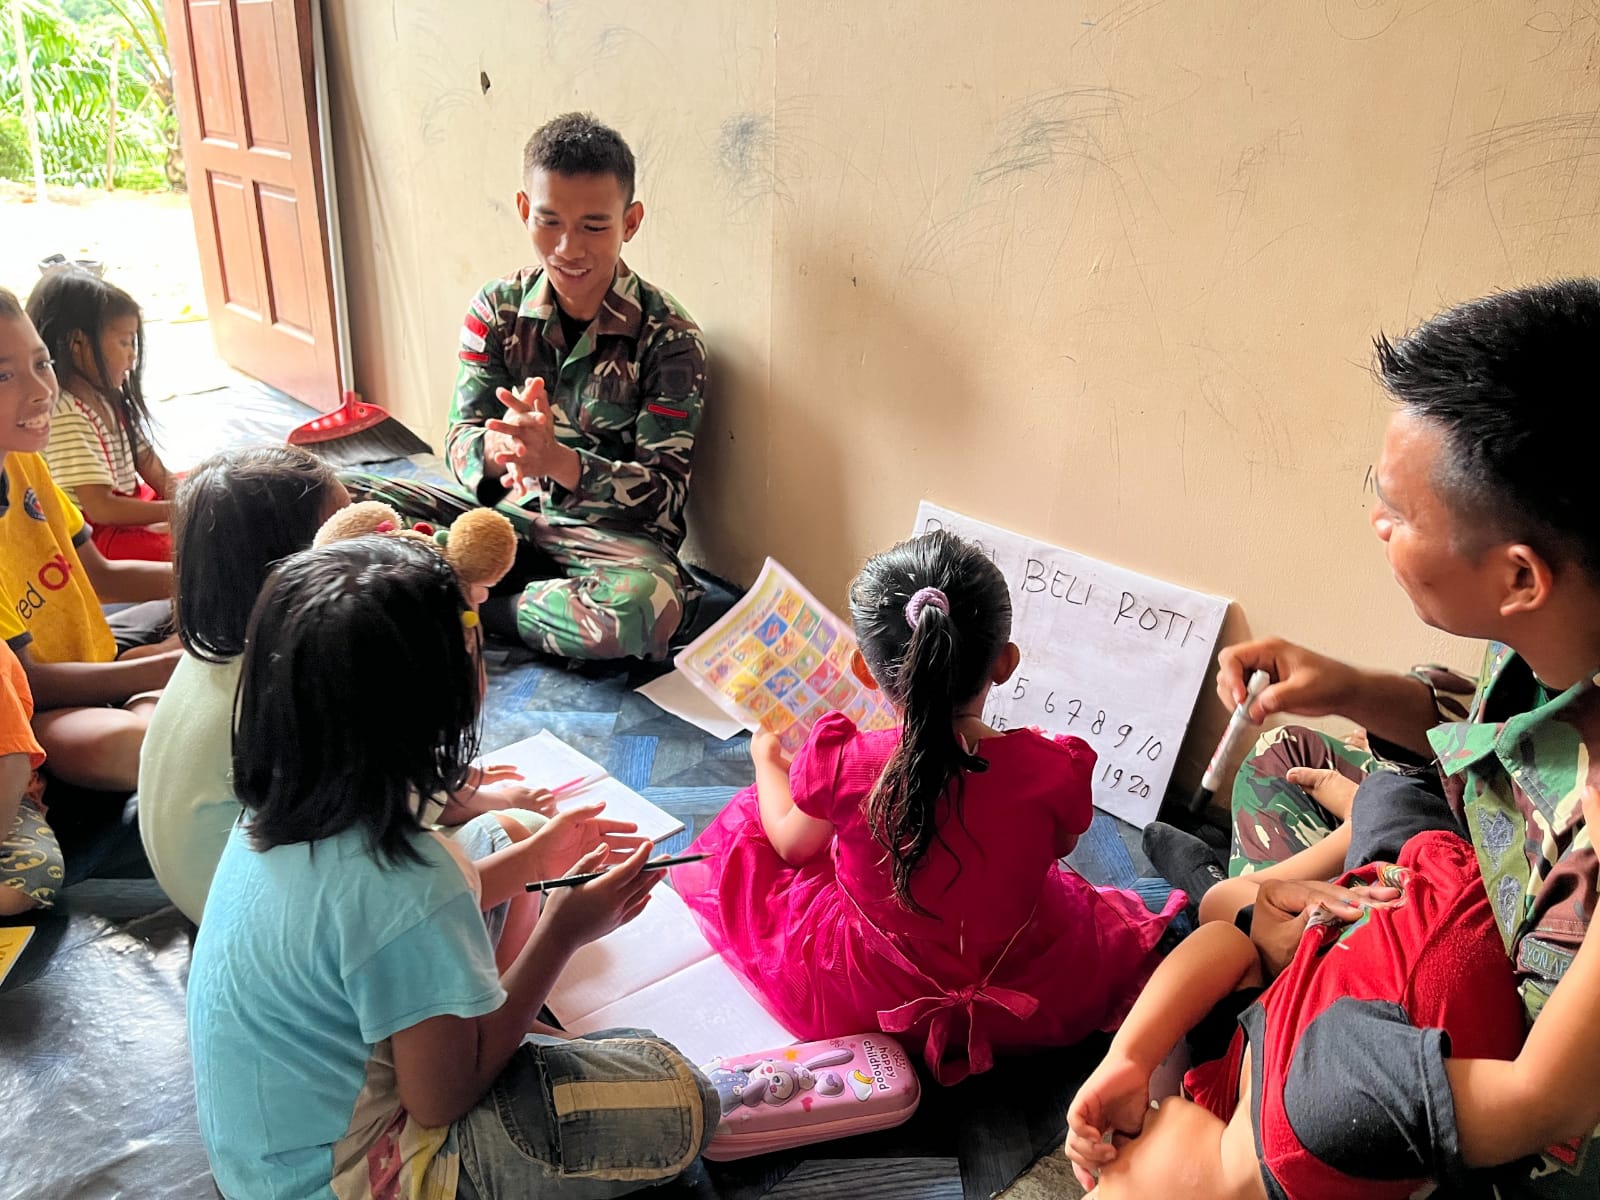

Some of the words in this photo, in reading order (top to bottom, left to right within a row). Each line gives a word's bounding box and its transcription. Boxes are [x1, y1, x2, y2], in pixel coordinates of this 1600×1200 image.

[1021, 559, 1095, 606] BELI
[1012, 677, 1029, 700] 5
[1044, 691, 1055, 713] 6
[1067, 700, 1082, 726] 7
[1091, 710, 1105, 734] 8
[1113, 724, 1132, 748] 9
[1137, 735, 1162, 761] 10
[1102, 764, 1122, 788] 19
[1128, 774, 1151, 798] 20
[1525, 946, 1548, 969] YON
[863, 1040, 890, 1091] childhood
[879, 1046, 897, 1078] happy
